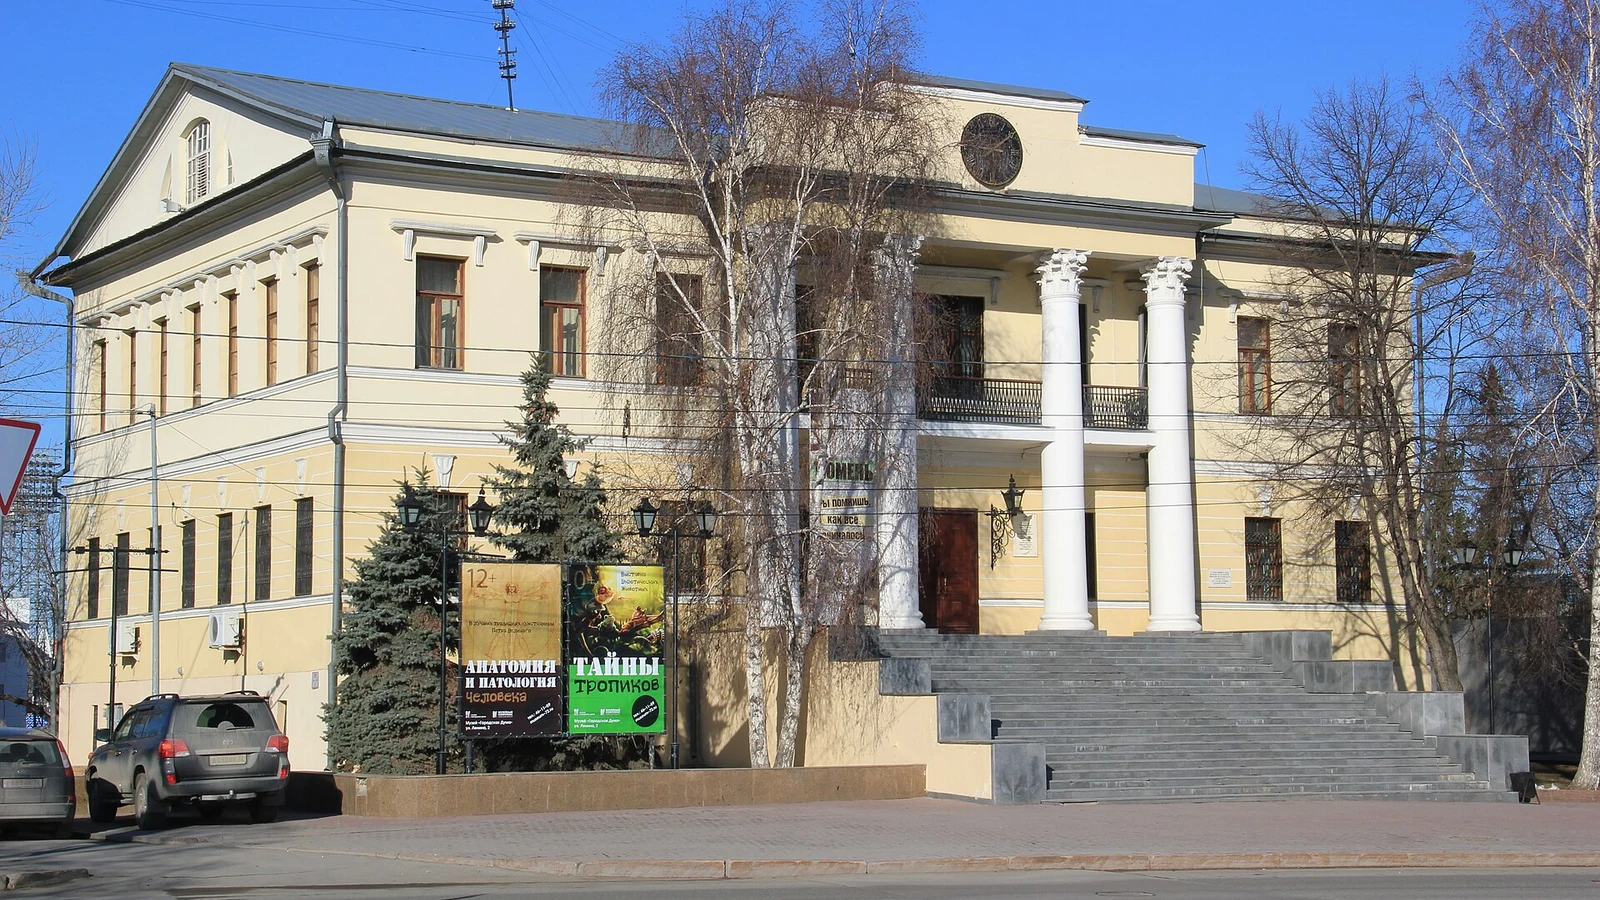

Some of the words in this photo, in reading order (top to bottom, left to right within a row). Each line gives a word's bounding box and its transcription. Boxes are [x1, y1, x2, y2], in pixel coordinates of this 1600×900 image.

[827, 515, 842, 525] как
[467, 568, 497, 589] 12+
[465, 660, 557, 674] АНАТОМИЯ
[573, 651, 660, 676] ТАЙНЫ
[465, 677, 475, 689] И
[479, 676, 557, 688] ПАТОЛОГИЯ
